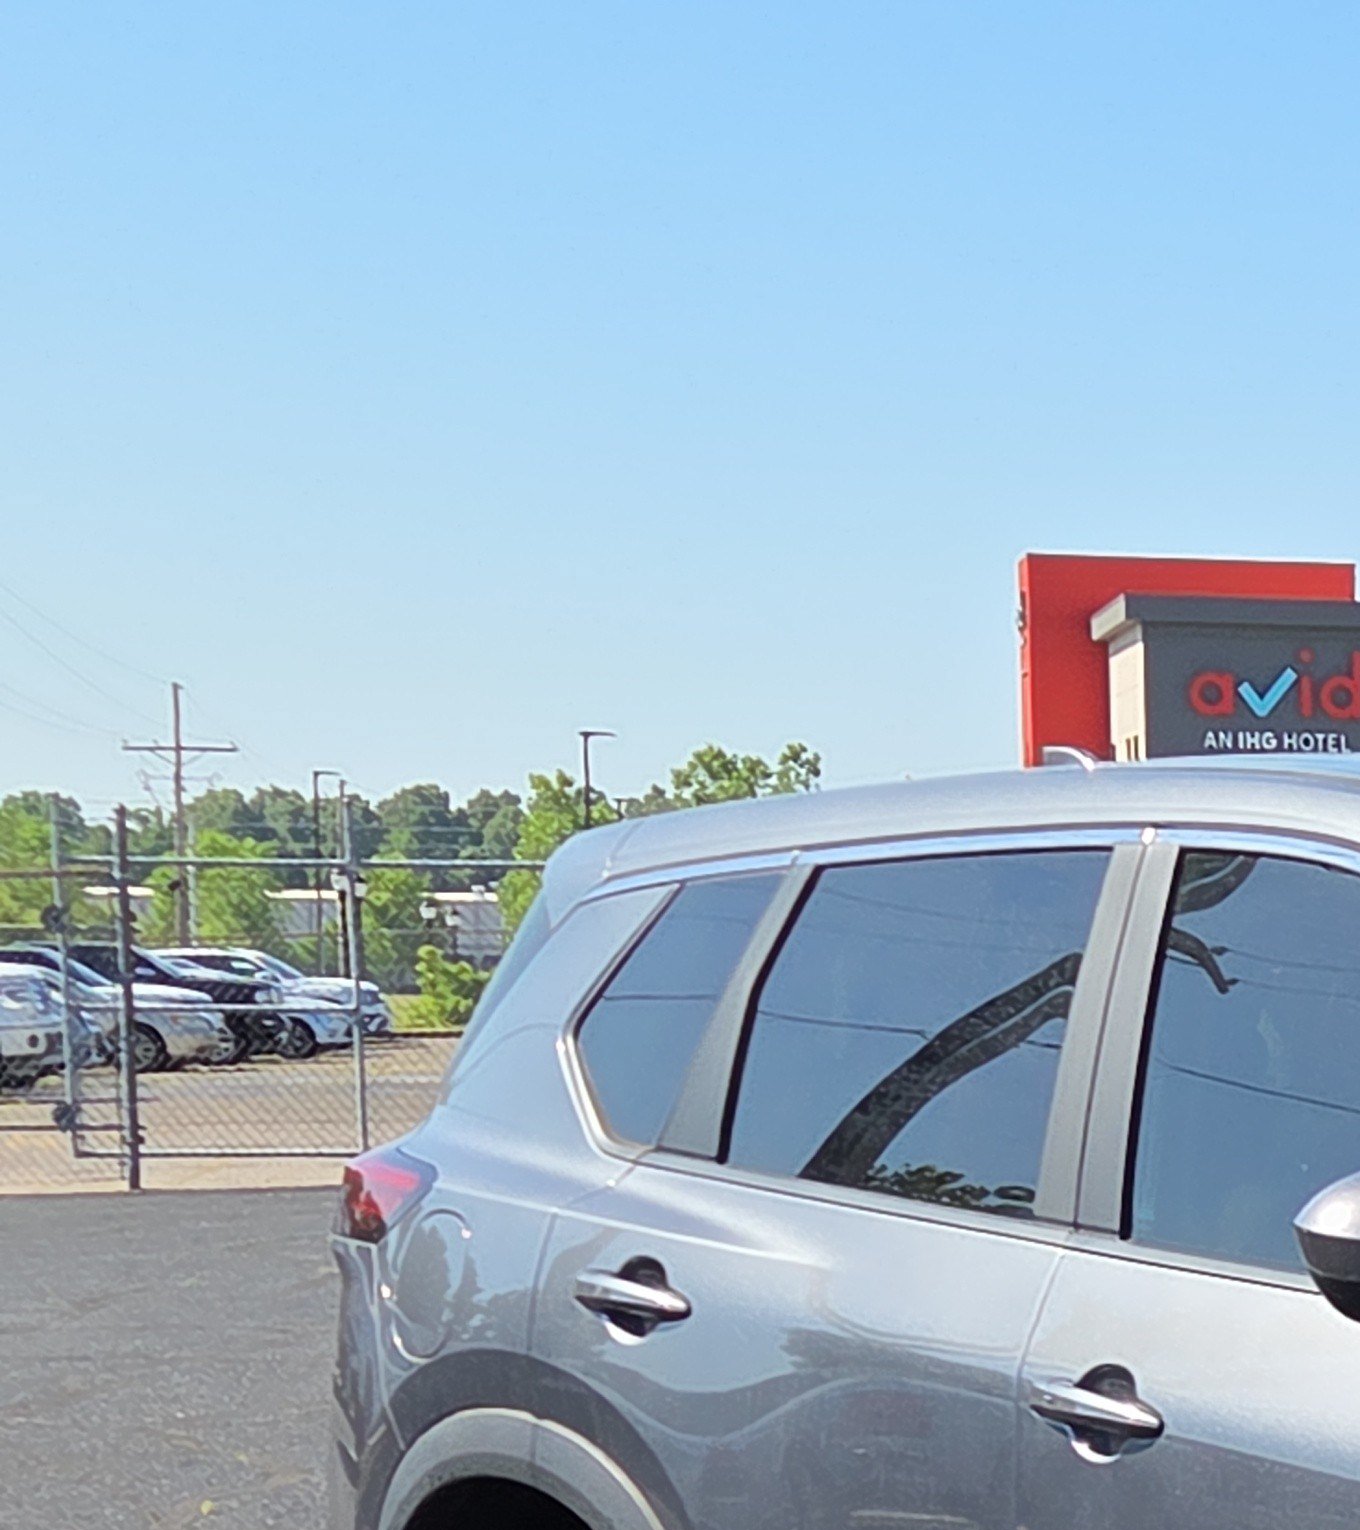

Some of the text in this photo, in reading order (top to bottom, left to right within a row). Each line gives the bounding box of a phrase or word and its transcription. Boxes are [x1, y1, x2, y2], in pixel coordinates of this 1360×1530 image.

[1203, 730, 1351, 753] AN IHG HOTEL
